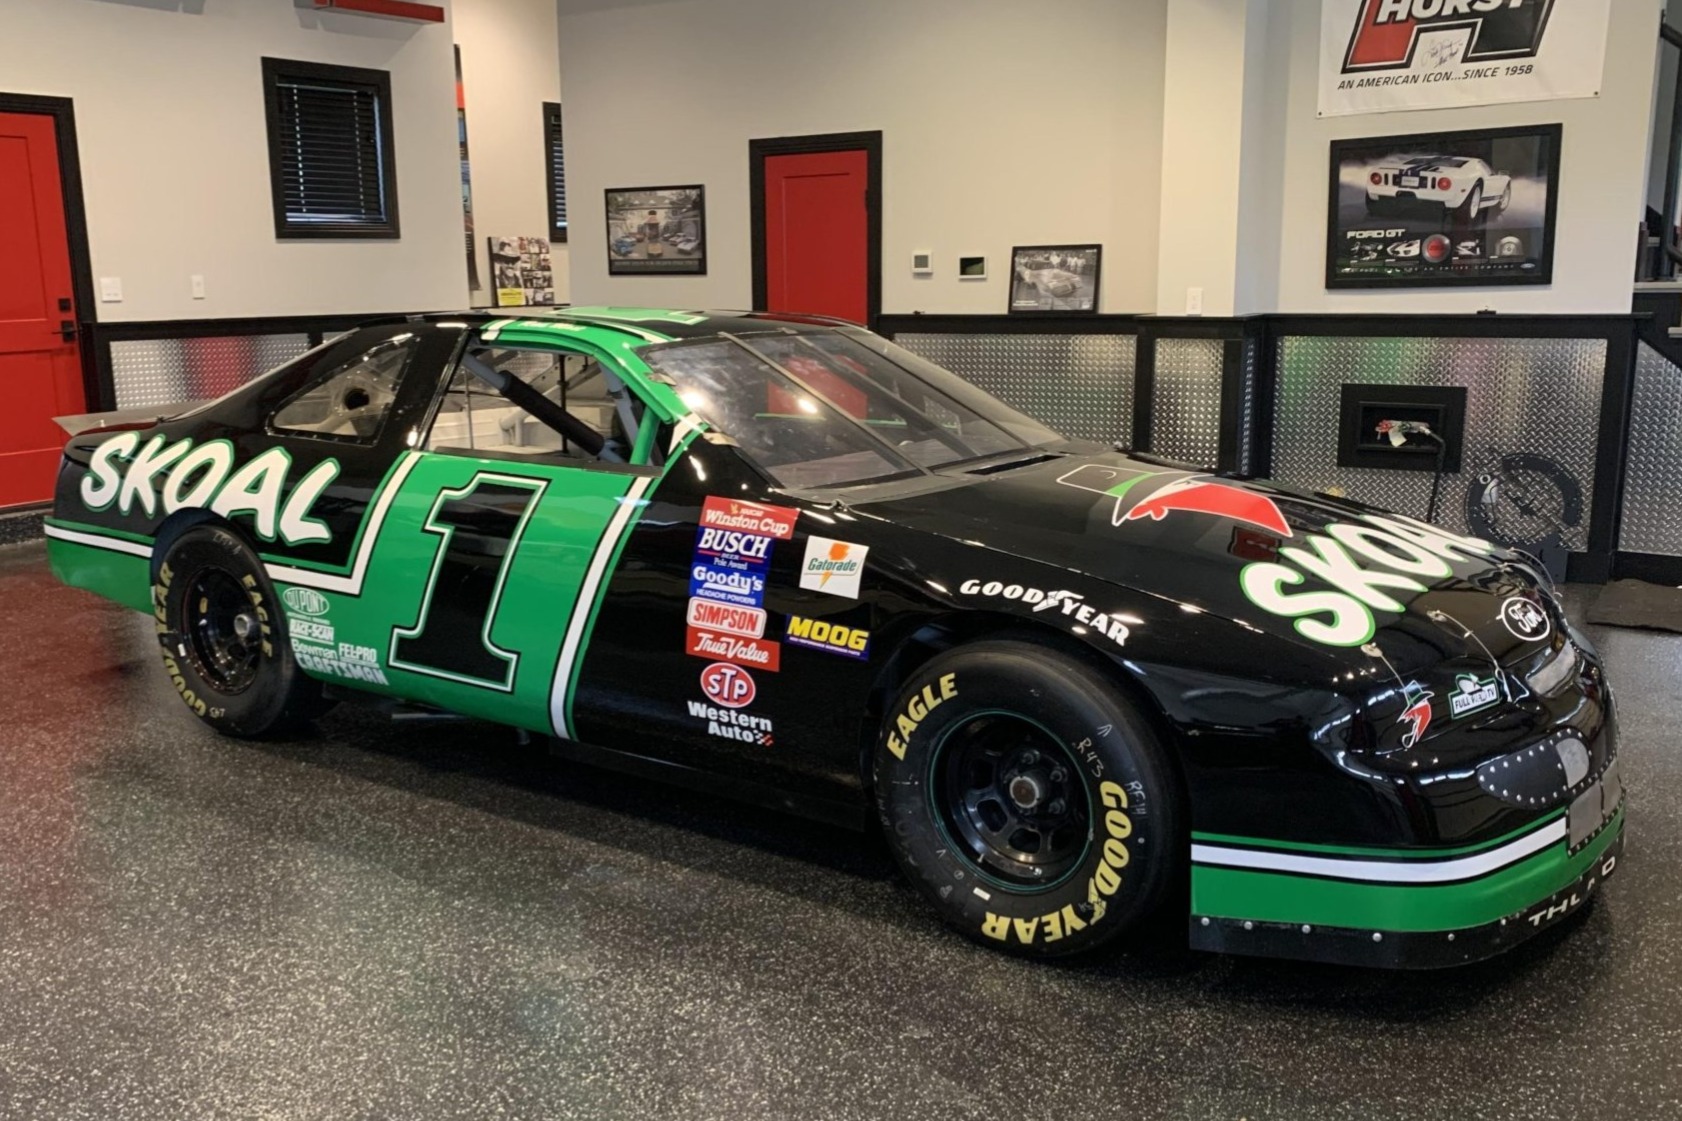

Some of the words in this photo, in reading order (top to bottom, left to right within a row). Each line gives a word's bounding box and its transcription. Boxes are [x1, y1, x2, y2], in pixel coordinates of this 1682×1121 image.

[1338, 80, 1353, 90] AN
[1356, 75, 1418, 88] AMERICAN
[1504, 65, 1533, 76] 1958
[1346, 230, 1384, 239] FORD
[1386, 229, 1406, 237] GT
[80, 432, 338, 544] SKOAL
[705, 510, 758, 530] Winston
[759, 518, 790, 537] Cup
[698, 528, 772, 558] BUSCH
[693, 566, 763, 592] Goody's
[808, 558, 857, 571] Gatorade
[390, 471, 552, 695] 1
[242, 573, 273, 658] EAGLE
[286, 590, 324, 612] DUPONT
[693, 603, 759, 632] SIMPSON
[787, 616, 869, 651] MOOG
[290, 638, 337, 659] Bowman
[294, 653, 389, 686] CRAFTSMAN
[708, 668, 748, 699] STP
[687, 700, 772, 732] Western
[886, 672, 959, 761] EAGLE
[708, 721, 755, 742] Auto
